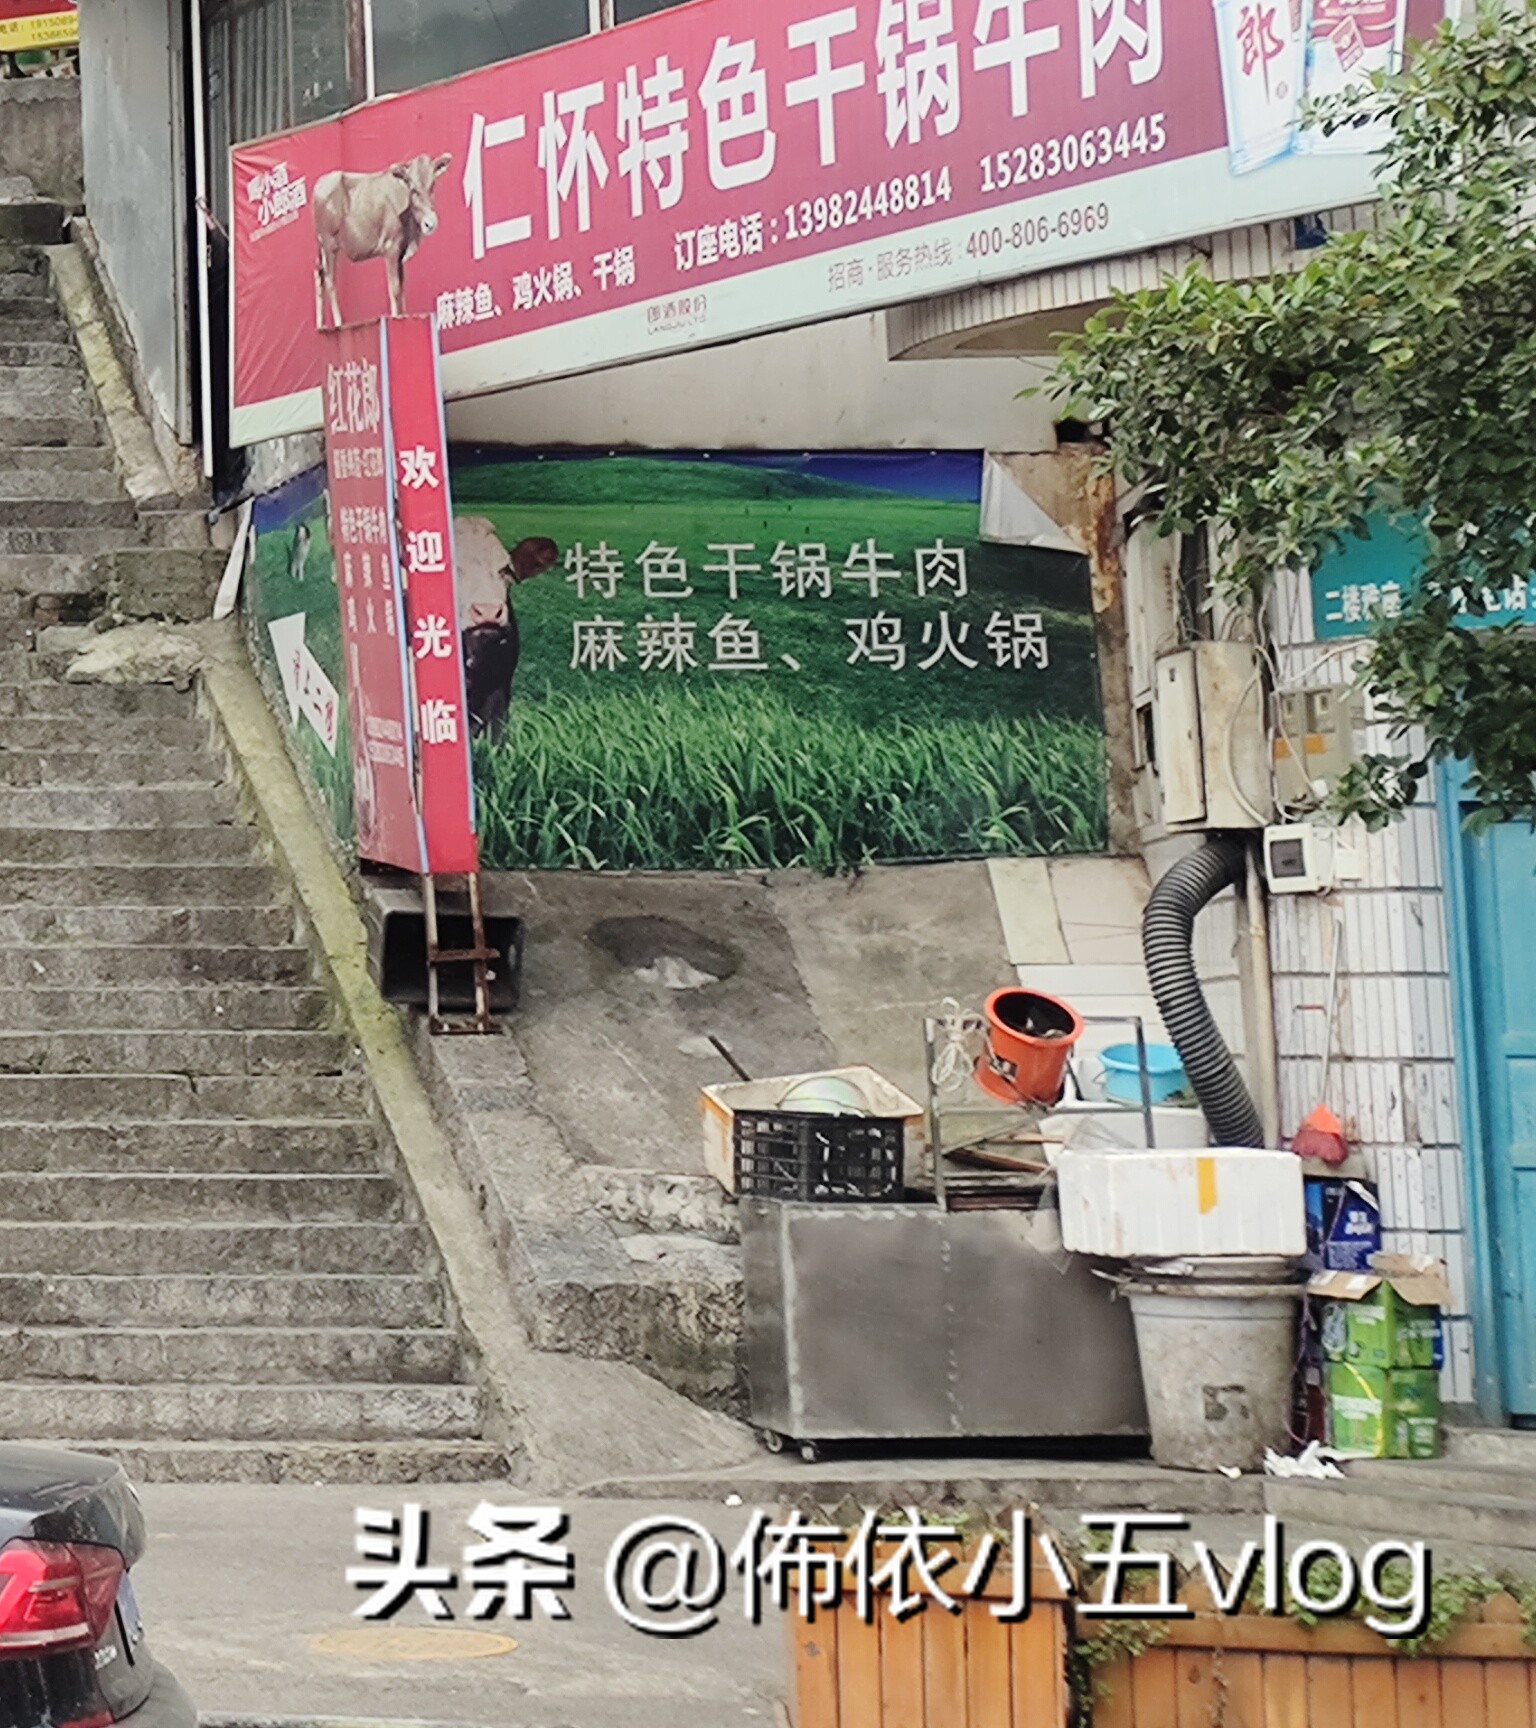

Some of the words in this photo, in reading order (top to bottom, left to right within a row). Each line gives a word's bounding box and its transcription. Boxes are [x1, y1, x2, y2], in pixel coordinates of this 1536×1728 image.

[980, 112, 1168, 193] 15283063445
[257, 176, 307, 227] 小郎酒
[328, 357, 380, 435] 红花郎
[398, 444, 459, 745] 欢迎光临
[564, 538, 969, 602] 特色干锅牛肉
[569, 610, 1050, 674] 麻辣鱼、鸡火锅
